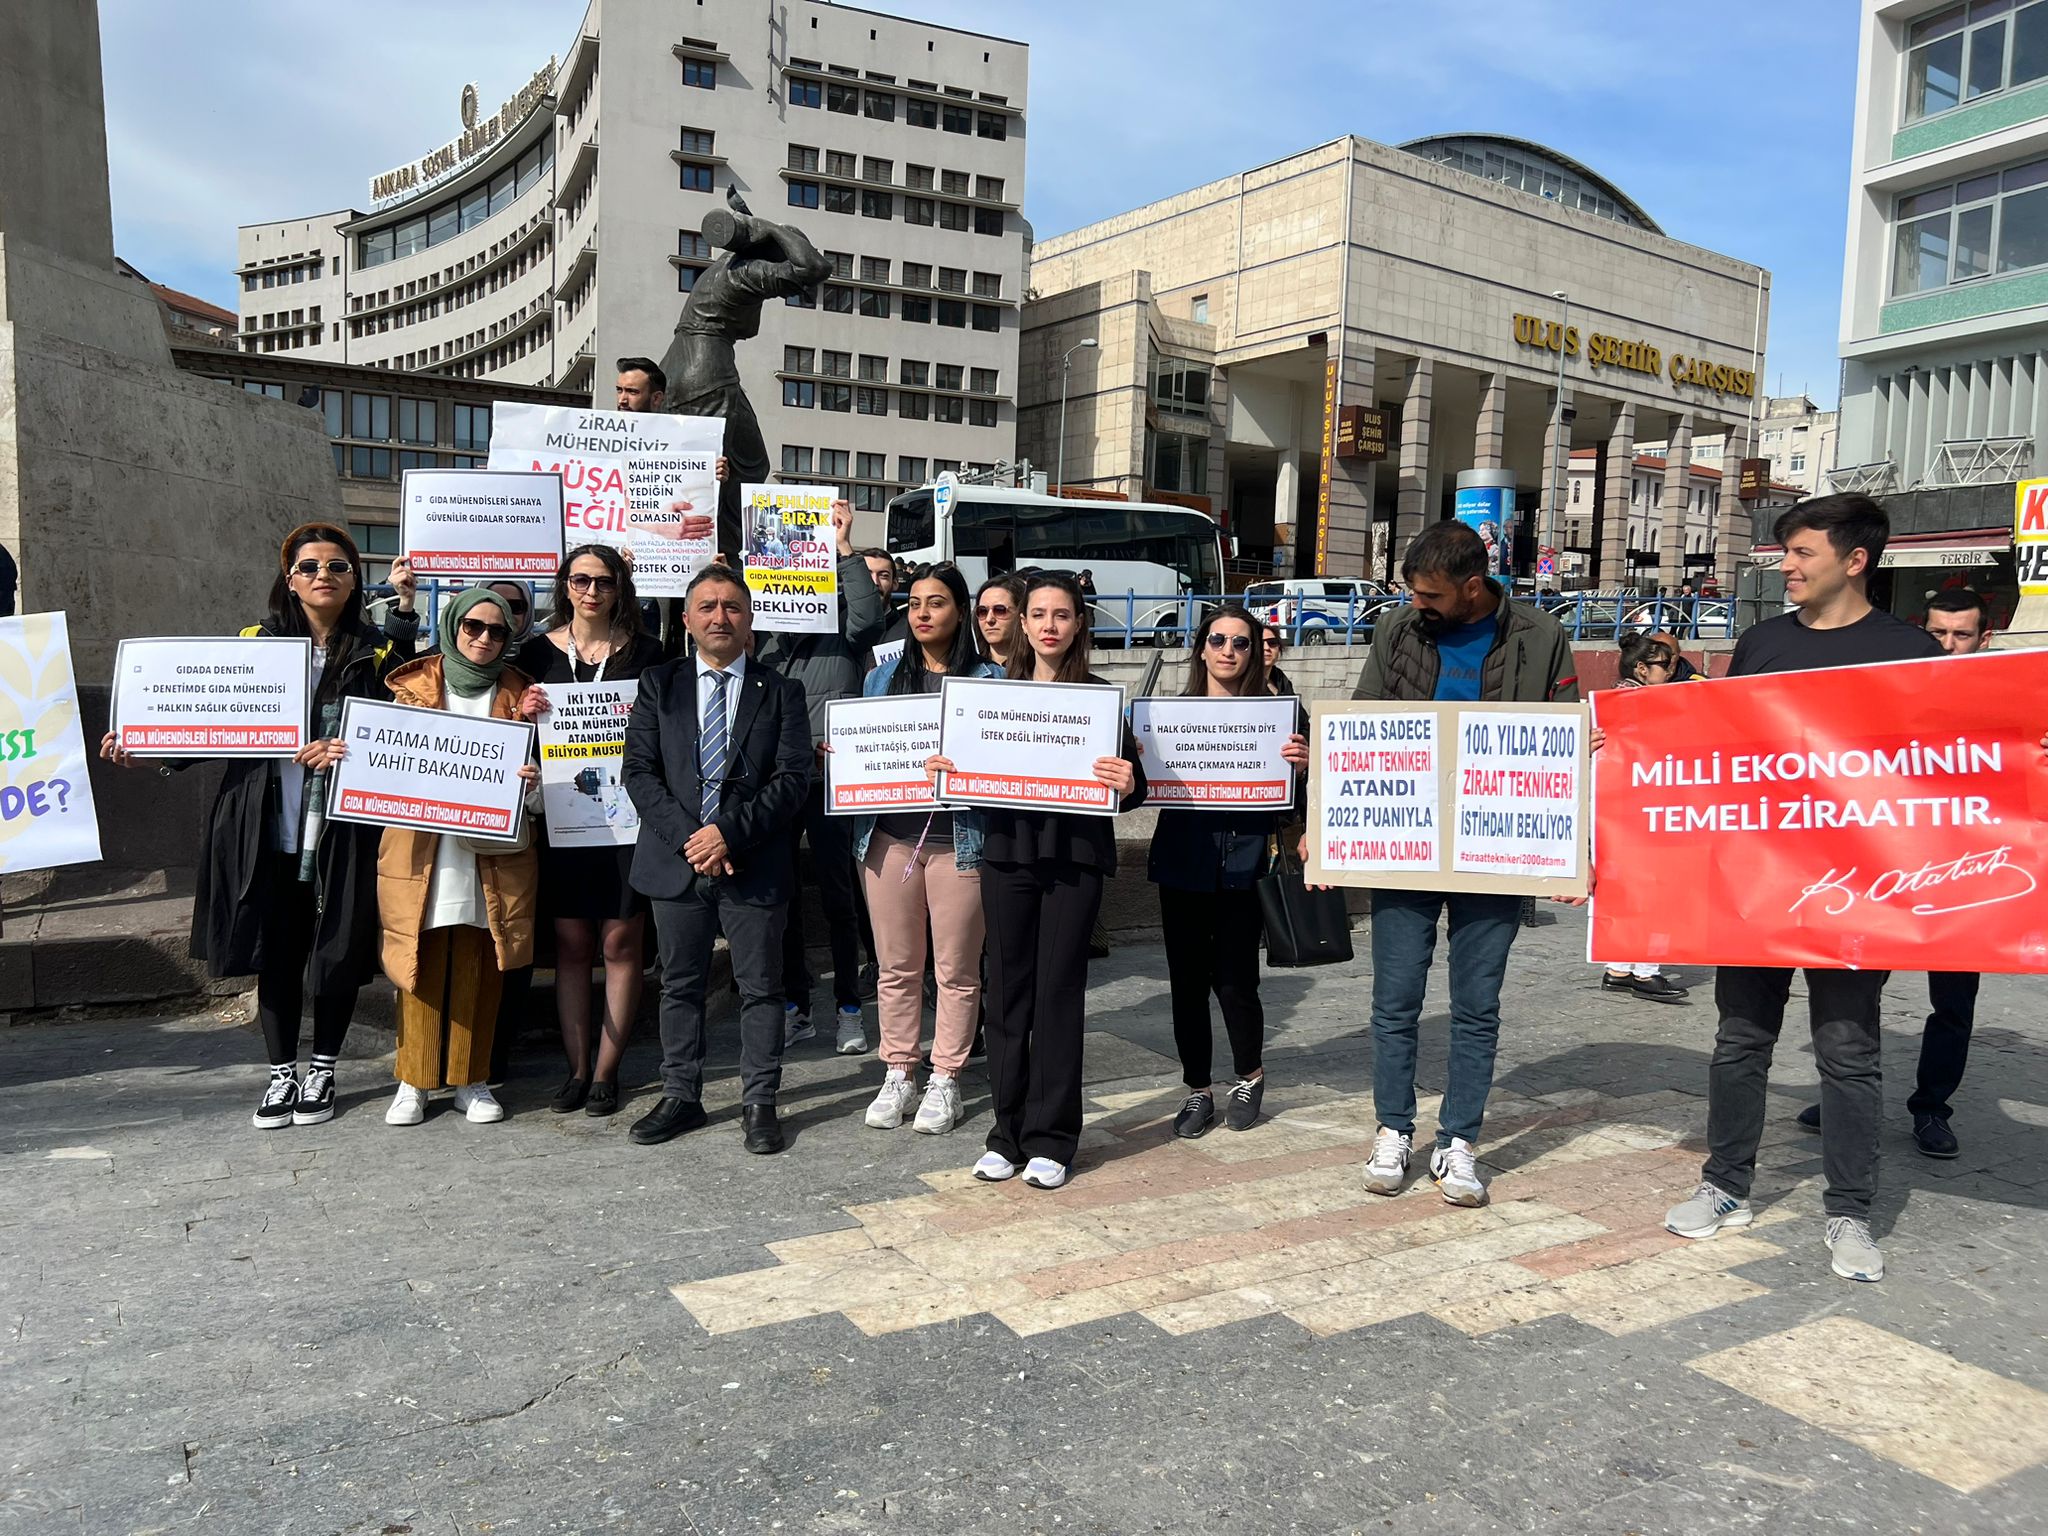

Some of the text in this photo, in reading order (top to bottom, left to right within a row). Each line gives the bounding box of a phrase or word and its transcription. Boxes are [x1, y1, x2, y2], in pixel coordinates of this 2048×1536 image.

[373, 165, 418, 200] ANKARA
[422, 144, 456, 182] SOSYAL
[1513, 313, 1755, 397] ULUS ŞEHİR ÇARŞISI
[578, 413, 638, 433] ZİRAAT
[1364, 413, 1381, 425] ULUS
[1362, 426, 1382, 439] ŞEHİR
[1358, 440, 1384, 454] ÇARŞISI
[628, 458, 707, 470] MÜHENDİSİNE
[1316, 366, 1334, 574] ULUS ŞEHİR ÇARŞISI
[629, 472, 682, 486] SAHİP ÇIK
[629, 484, 673, 496] YEDİĞİN
[430, 494, 542, 506] GIDA MÜHENDİSLERİ SAHAYA
[630, 498, 659, 509] ZEHİR
[752, 490, 830, 511] İŞİ EHLİNE
[426, 511, 541, 523] GÜVENİLİR GIDALAR SOFRAYA
[566, 499, 626, 532] EĞİL
[630, 513, 681, 522] OLMASIN
[782, 512, 830, 526] BIRAK
[789, 540, 829, 554] GIDA
[901, 542, 917, 550] ISUZU
[412, 554, 555, 570] GIDA MÜHENDİSLERİ İSTİHDAM PLATFORMU
[748, 553, 830, 570] BİZİM İŞİMİZ
[632, 564, 691, 574] DESTEK OL!
[770, 574, 828, 582] MÜHENDİSLERİ
[762, 584, 816, 596] ATAMA
[752, 600, 827, 614] BEKLİYOR
[880, 649, 904, 664] KALİ
[176, 664, 254, 674] GIDADA DENETİM
[153, 683, 206, 693] DENETİMDE
[208, 685, 231, 693] GIDA
[233, 683, 286, 693] MÜHENDİSİ
[568, 692, 620, 705] İKİ YILDA
[157, 702, 280, 713] HALKIN SAĞLIK GÜVENCESİ
[558, 706, 608, 717] YALNIZCA
[978, 710, 1090, 725] GIDA MÜHENDİSİ ATAMASI
[554, 720, 578, 730] GIDA
[840, 721, 939, 736] GIDA MÜHENDİSLERİ SAHA
[1157, 723, 1276, 733] HALK GÜVENLE TÜKETSİN DİYE
[1328, 720, 1431, 741] 2 YILDA SADECE
[126, 728, 296, 745] GIDA MÜHENDİSLERİ İSTİHDAM PLATFORMU
[568, 730, 624, 743] ATANDIĞIN
[981, 728, 1080, 747] İSTEK DEĞİL İHTİYAÇTIR
[1465, 724, 1574, 758] 100. YILDA 2000
[375, 728, 505, 760] ATAMA MÜJDESİ
[911, 742, 930, 750] GIDA
[1176, 741, 1257, 751] GIDA MÜHENDİSLERİ
[548, 746, 588, 757] BİLİYOR
[865, 761, 880, 771] HİLE
[883, 759, 910, 770] TARİHE
[1165, 761, 1260, 771] SAHAYA ÇIKMAYA HAZIR
[1328, 746, 1431, 772] 10 ZİRAAT TEKNİKERİ
[1632, 737, 2002, 787] MİLLİ EKONOMİNİN
[369, 751, 505, 784] VAHİT BAKANDAN
[1340, 779, 1415, 796] ATANDI
[1463, 763, 1572, 800] ZİRAAT TEKNİKERİ
[838, 791, 854, 803] GIDA
[855, 786, 903, 802] MÜHENDİSLERİ
[950, 776, 1106, 802] GIDA MÜHENDİSLERİ İSTİHDAM PLATFORMU
[1147, 784, 1283, 799] DA MÜHENDİSLERİ İSTİHDAM PLATFORMU
[344, 795, 507, 828] GIDA MÜHENDİSLERİ İSTİHDAM PLATFORMU
[1328, 807, 1433, 828] 2022 PUANIYLA
[1642, 794, 2002, 833] TEMELİ ZİRAATTIR.
[1461, 805, 1572, 840] İSTİHDAM BEKLİYOR
[1328, 840, 1432, 865] HİÇ ATAMA OLMADI
[1460, 851, 1566, 867] #ziraatteknikeri2000atama
